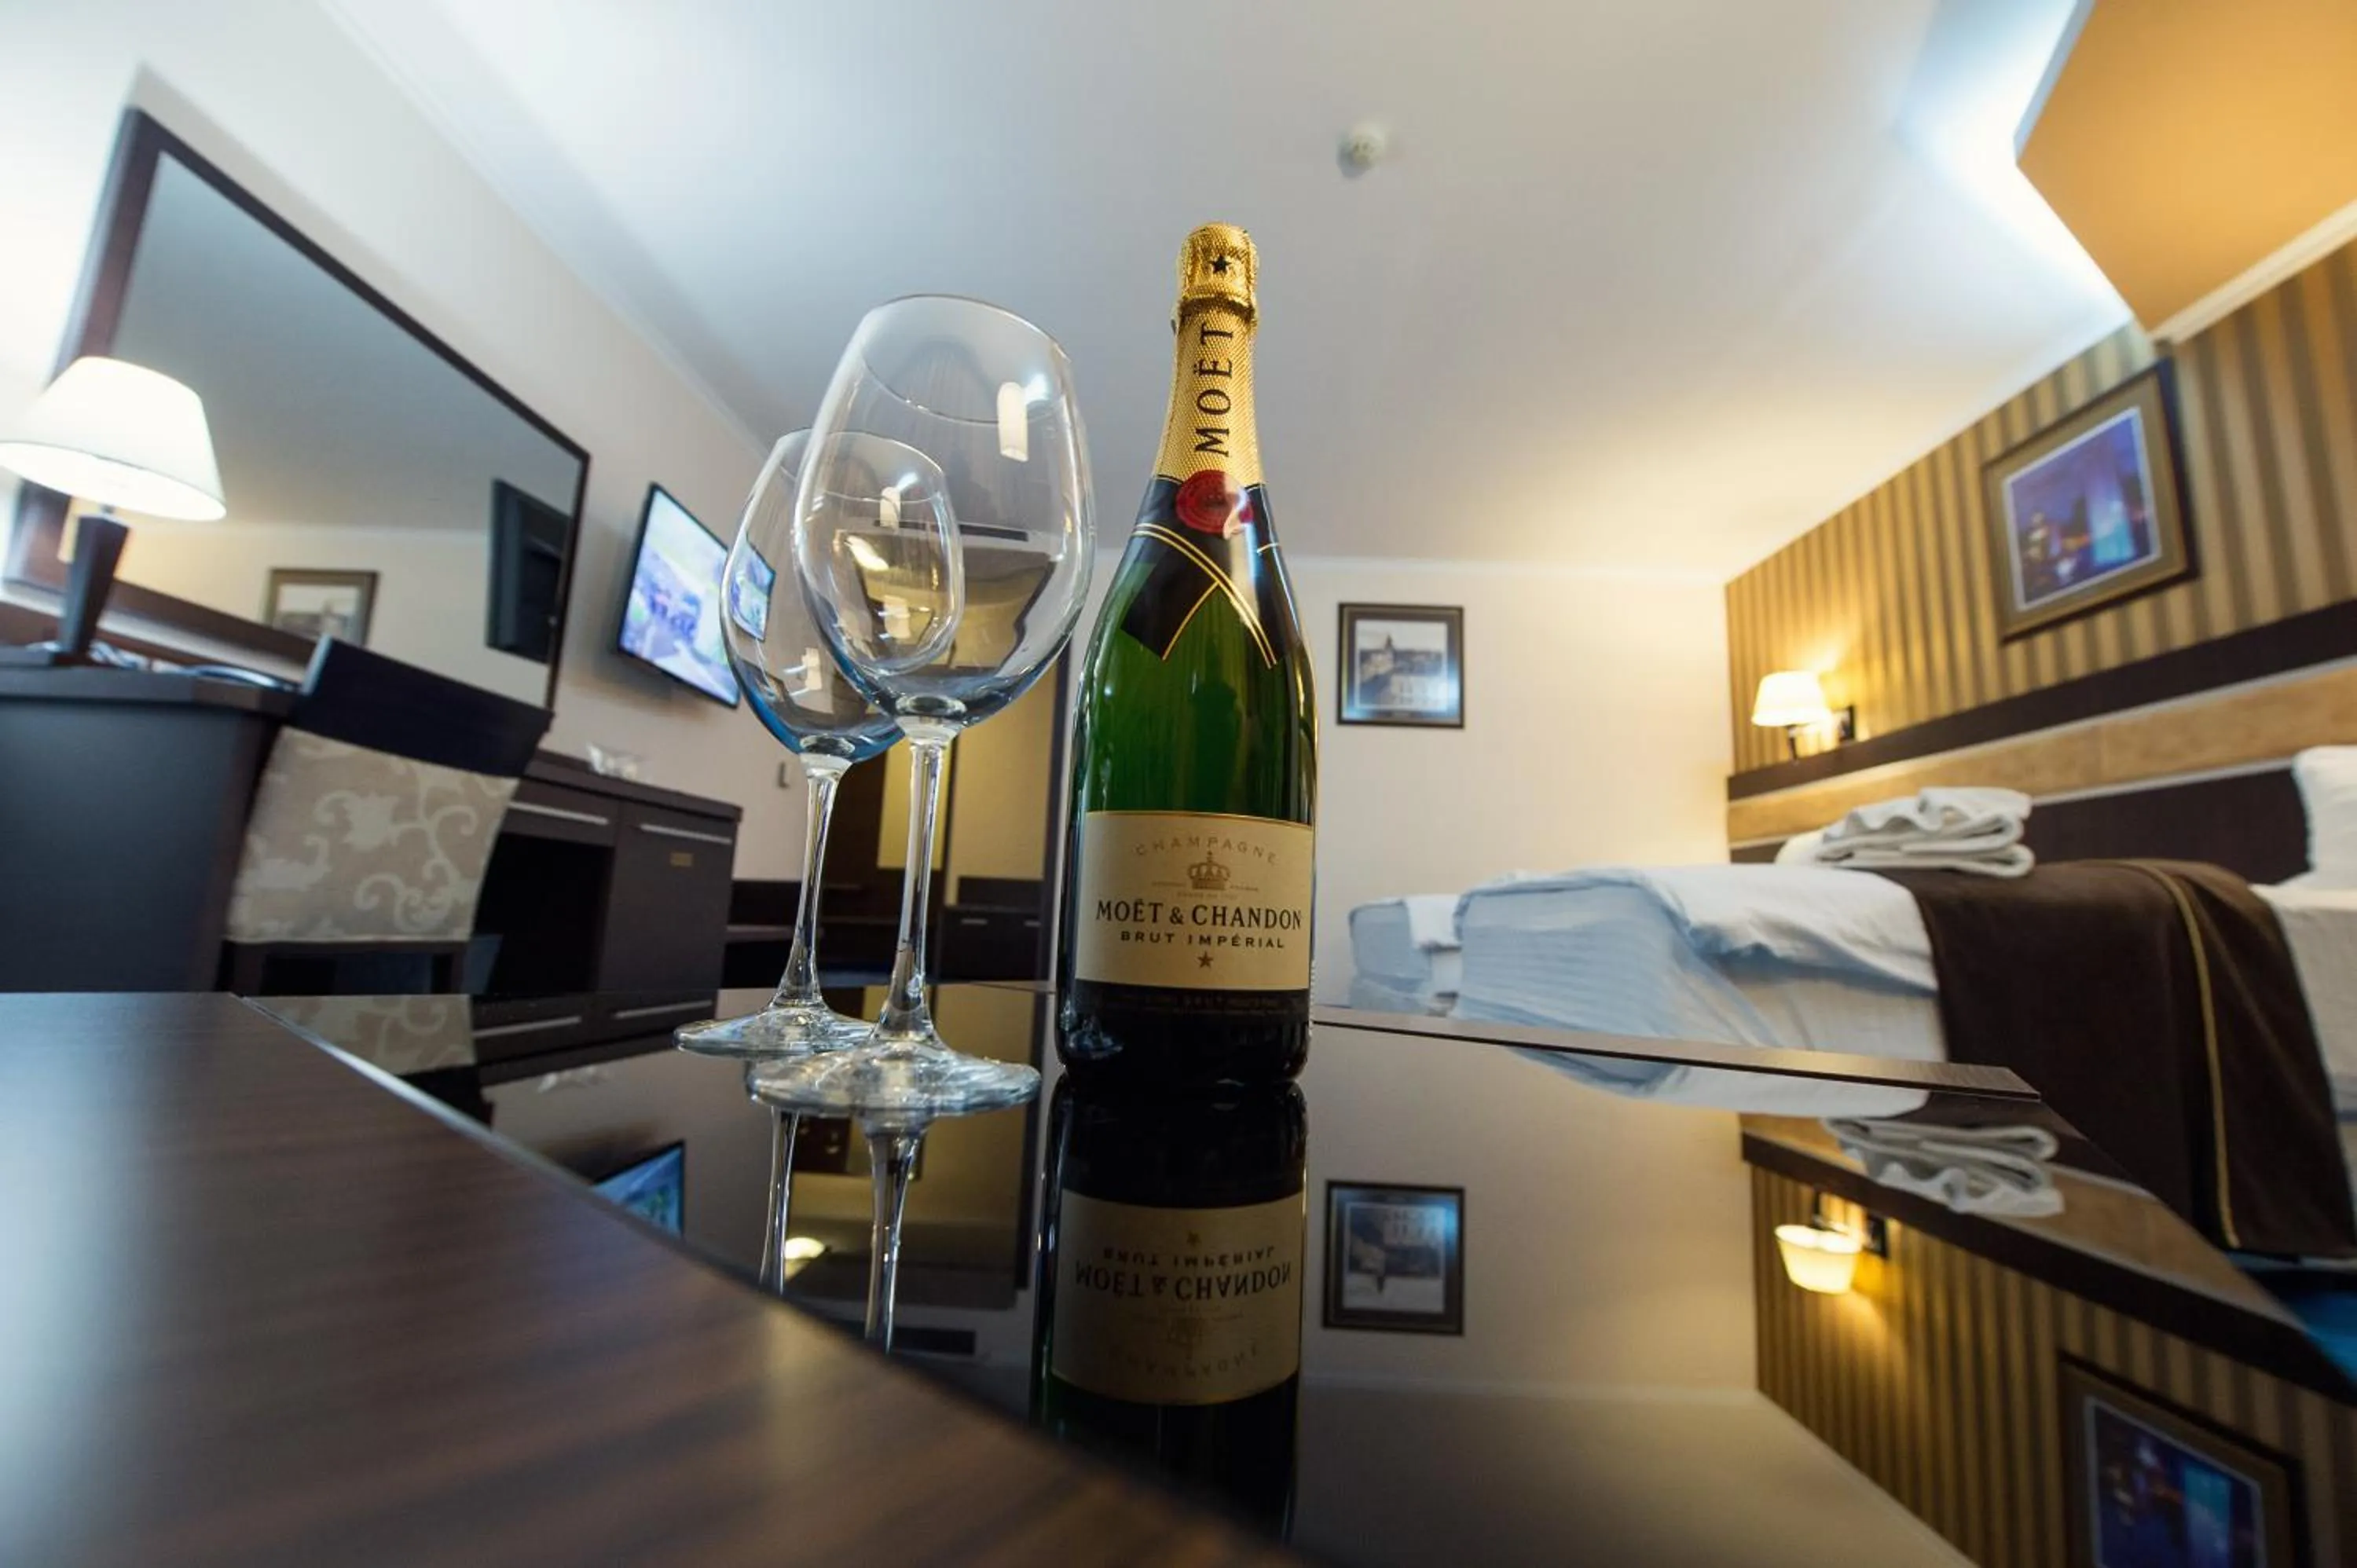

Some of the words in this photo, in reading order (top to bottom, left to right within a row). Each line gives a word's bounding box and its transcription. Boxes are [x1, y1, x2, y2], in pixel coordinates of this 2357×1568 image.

[1193, 323, 1234, 456] MOËT
[1137, 837, 1277, 865] CHAMPAGNE
[1096, 899, 1163, 923] MOËT
[1170, 907, 1184, 925] &
[1192, 905, 1301, 931] CHANDON
[1121, 931, 1175, 943] BRUT
[1189, 933, 1285, 949] IMPÉRIAL
